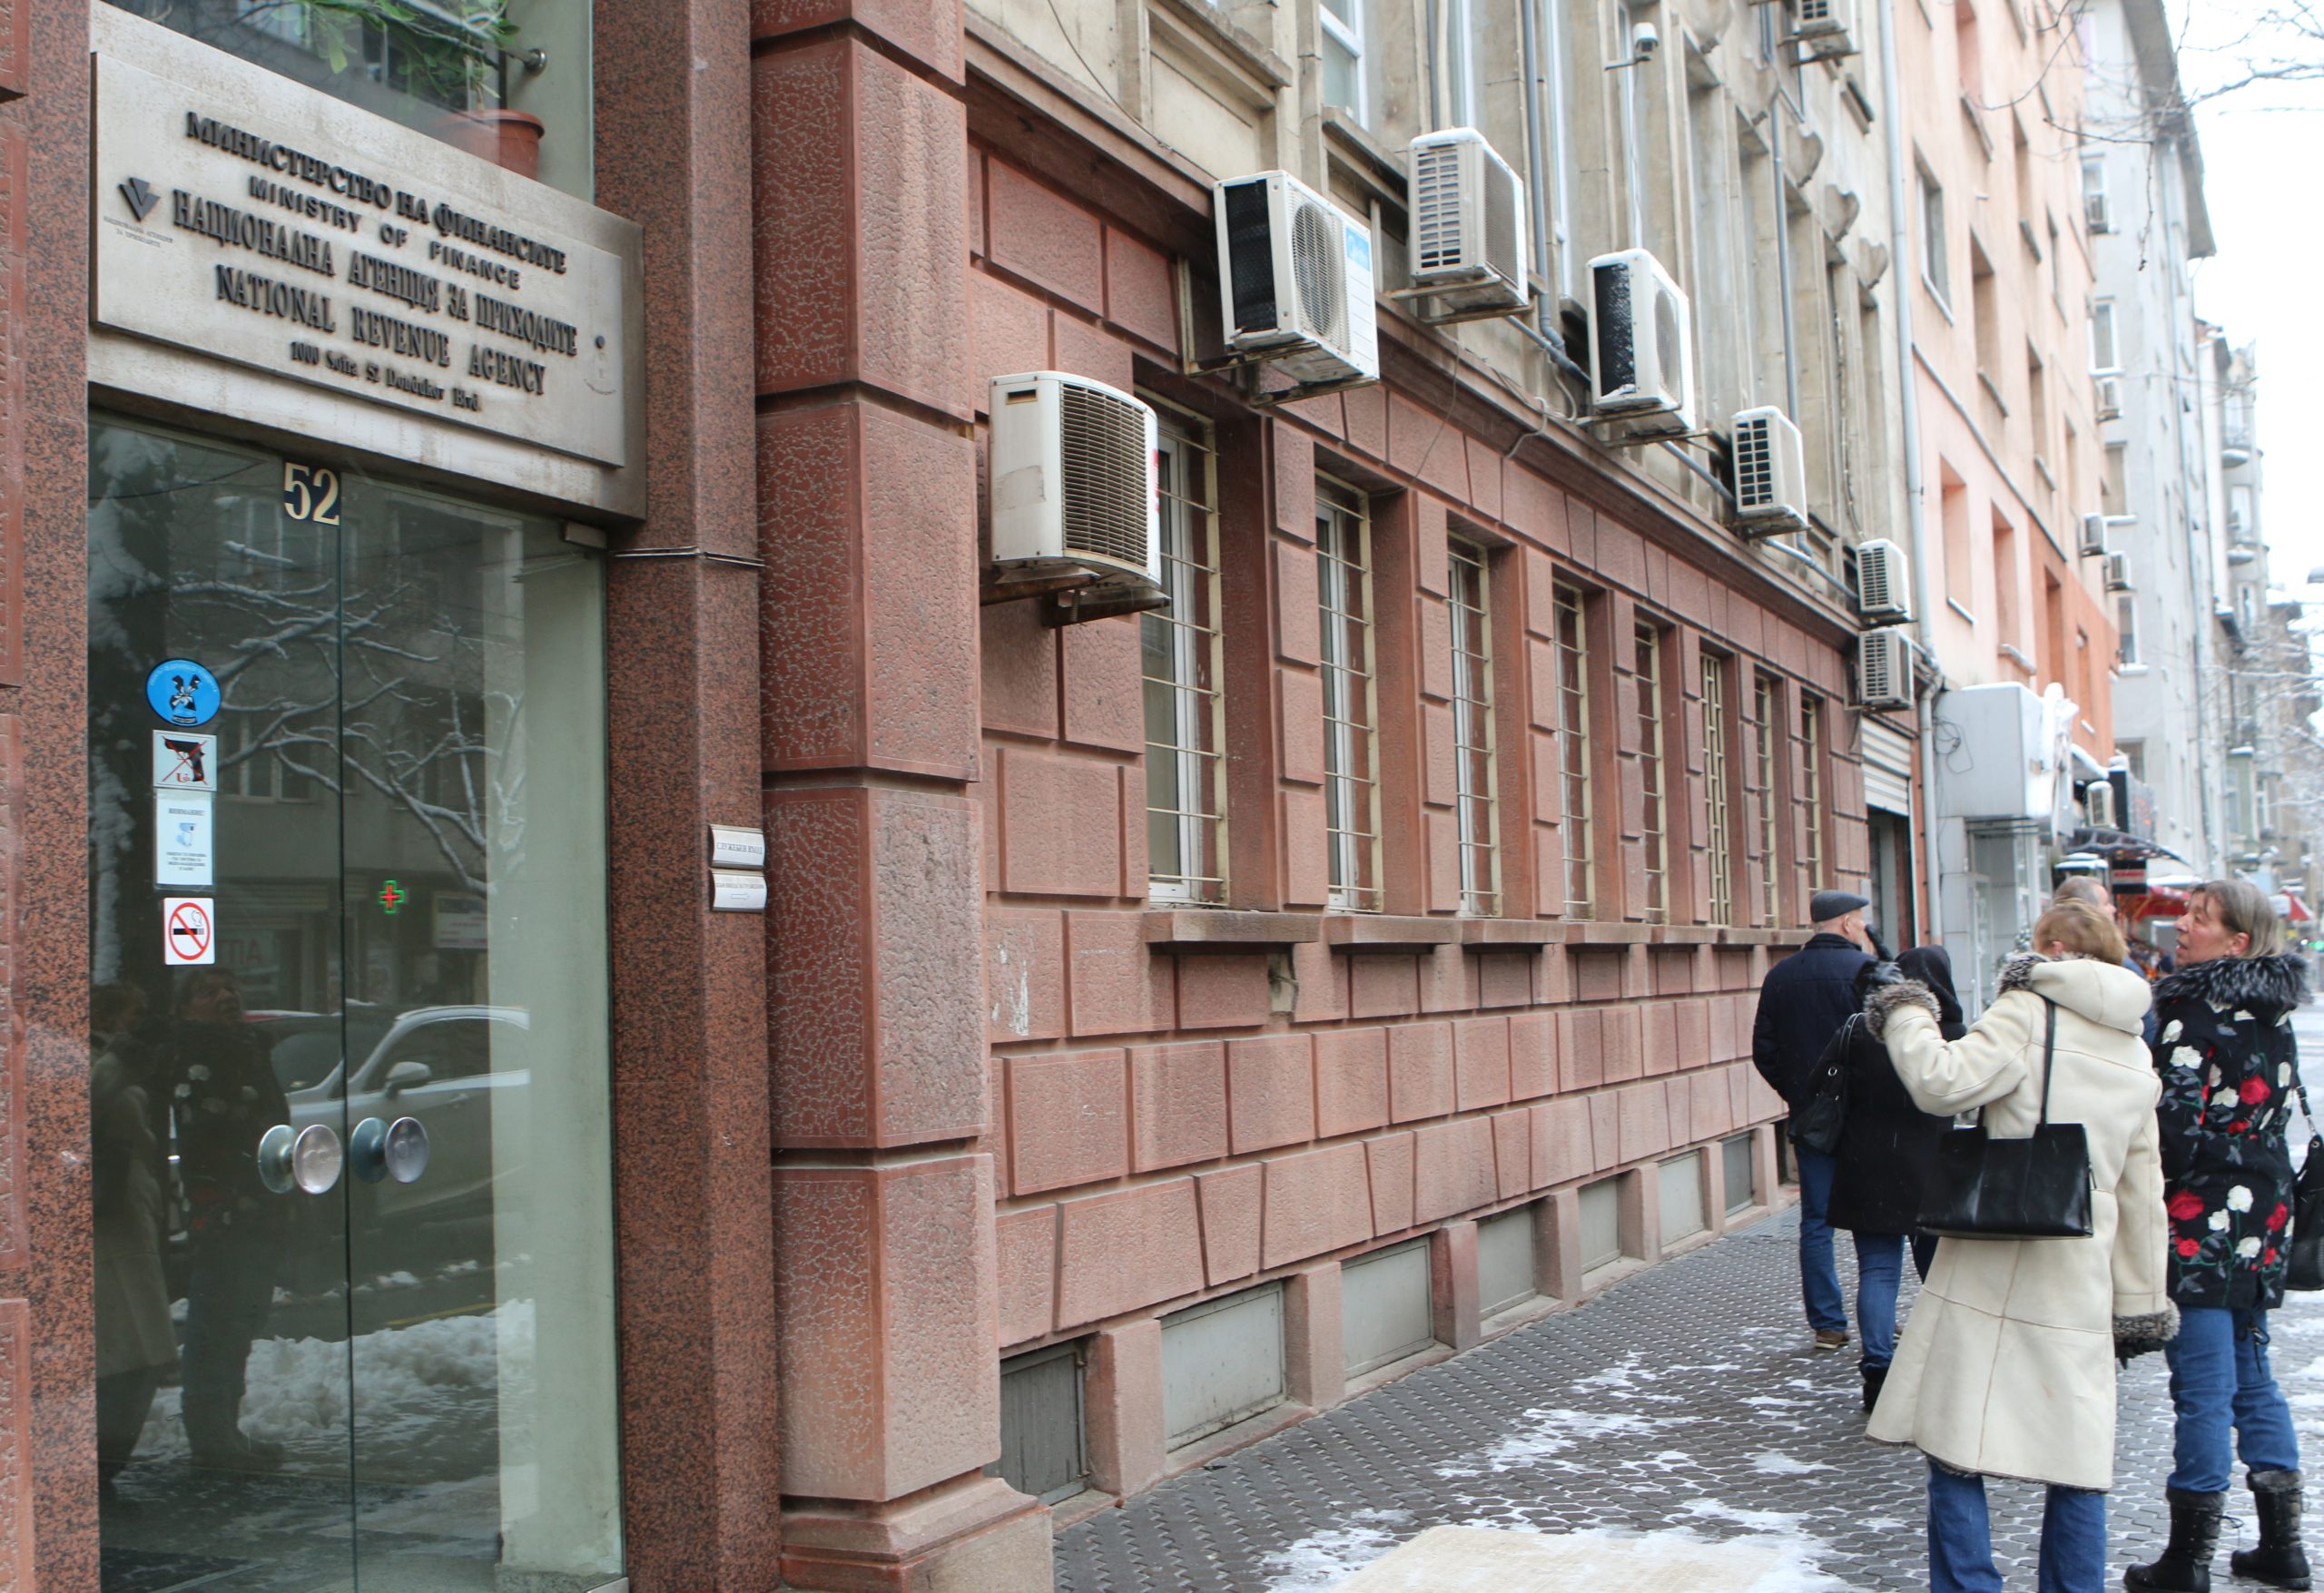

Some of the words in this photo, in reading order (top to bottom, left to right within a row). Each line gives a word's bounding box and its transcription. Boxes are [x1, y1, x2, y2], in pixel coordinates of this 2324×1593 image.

[187, 112, 391, 209] МИНИСТЕРСТВО
[397, 191, 429, 224] НА
[434, 203, 566, 274] ФИНАНСИТЕ
[250, 175, 362, 232] MINISTRY
[379, 224, 407, 248] OF
[429, 241, 520, 290] FINANCE
[173, 189, 335, 276] НАЦИОНАЛНА
[349, 251, 440, 312] АГЕНЦИЯ
[448, 282, 469, 320] ЗА
[476, 293, 577, 357] ПРИХОДИТЕ
[216, 264, 336, 332] NATIONAL
[352, 307, 450, 368] REVENUE
[468, 344, 546, 395] AGENCY
[290, 341, 319, 365] 1000
[366, 361, 379, 383] 52
[284, 461, 340, 526] 52
